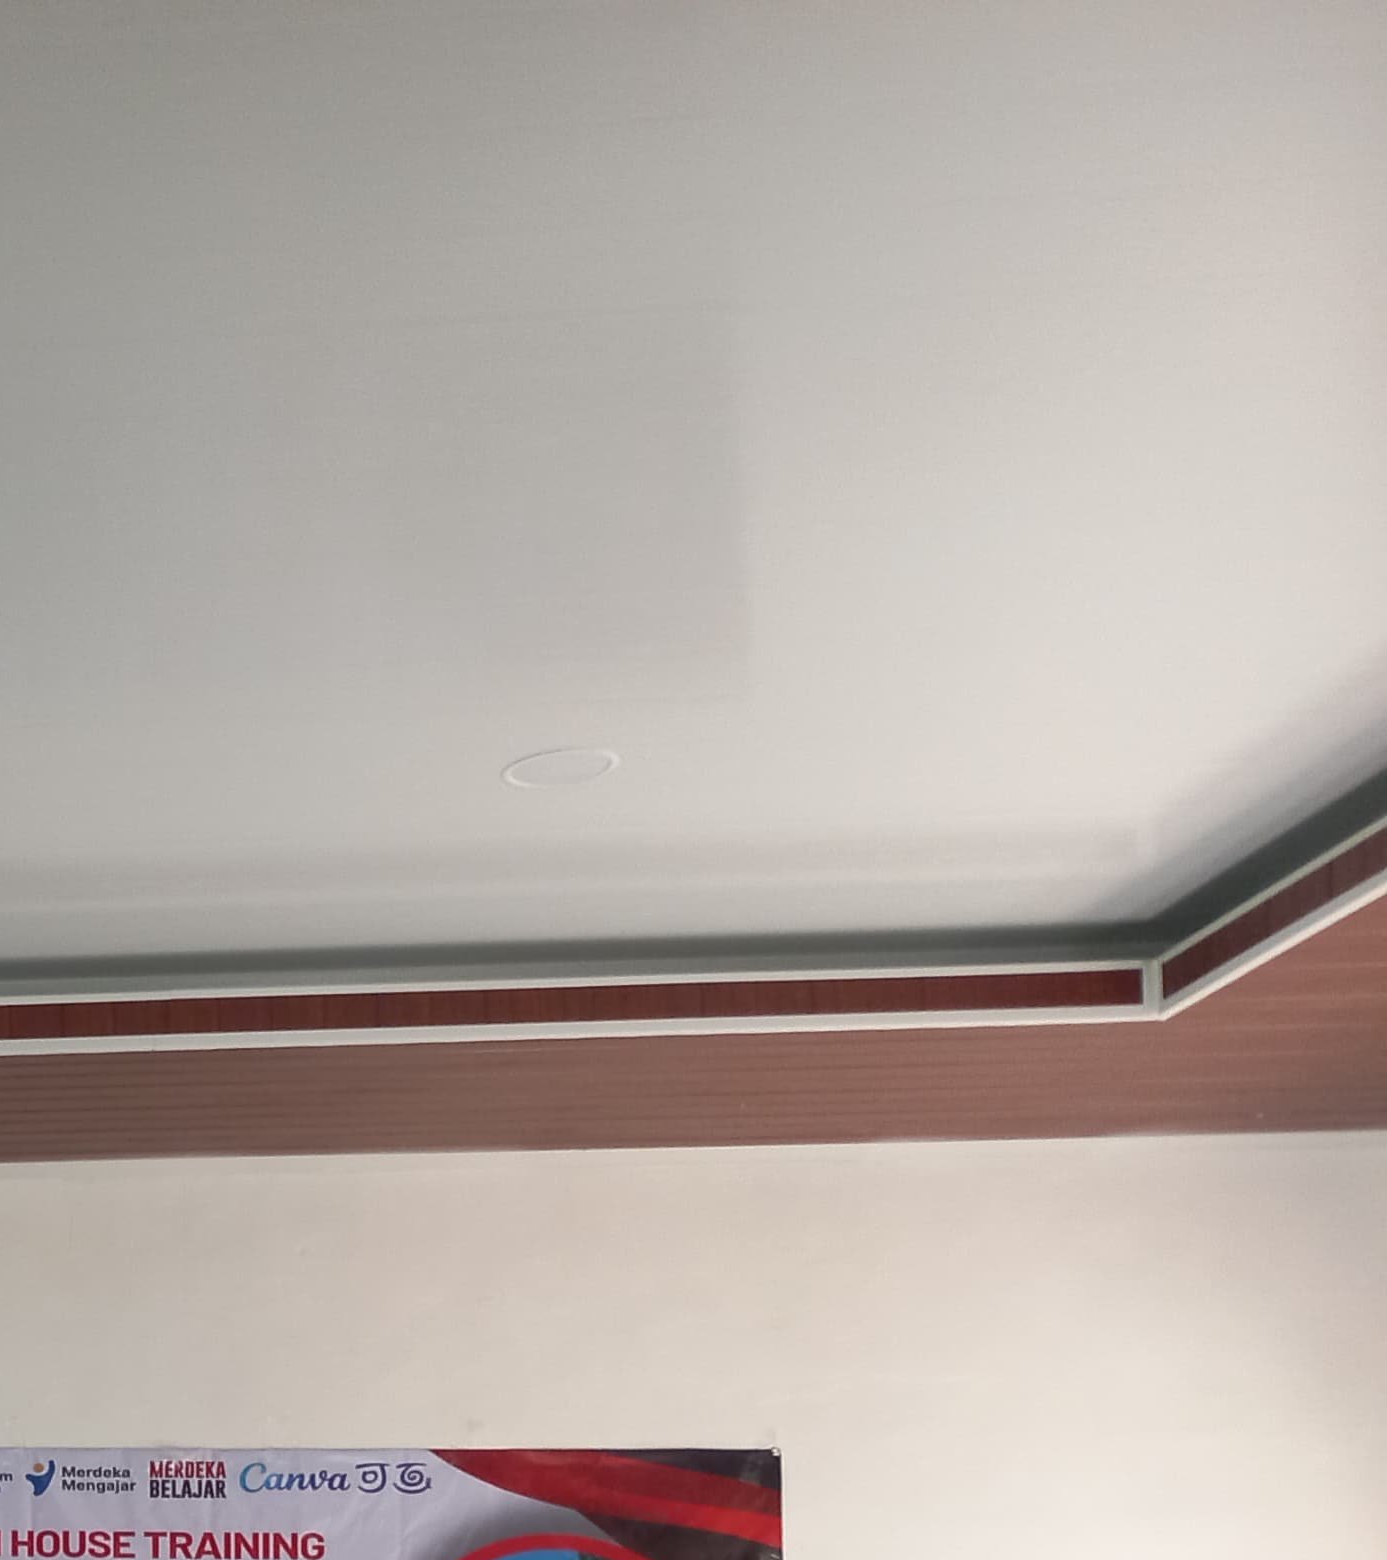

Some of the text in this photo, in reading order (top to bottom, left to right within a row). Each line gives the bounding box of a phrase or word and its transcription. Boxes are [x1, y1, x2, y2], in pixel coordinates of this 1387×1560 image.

[61, 1466, 131, 1478] Merdeka
[148, 1461, 226, 1479] MERDEKA
[238, 1462, 351, 1493] Canva
[61, 1479, 137, 1494] Mengajar
[148, 1479, 227, 1499] BELAJAR
[10, 1529, 136, 1559] HOUSE
[143, 1531, 326, 1560] TRAINING
